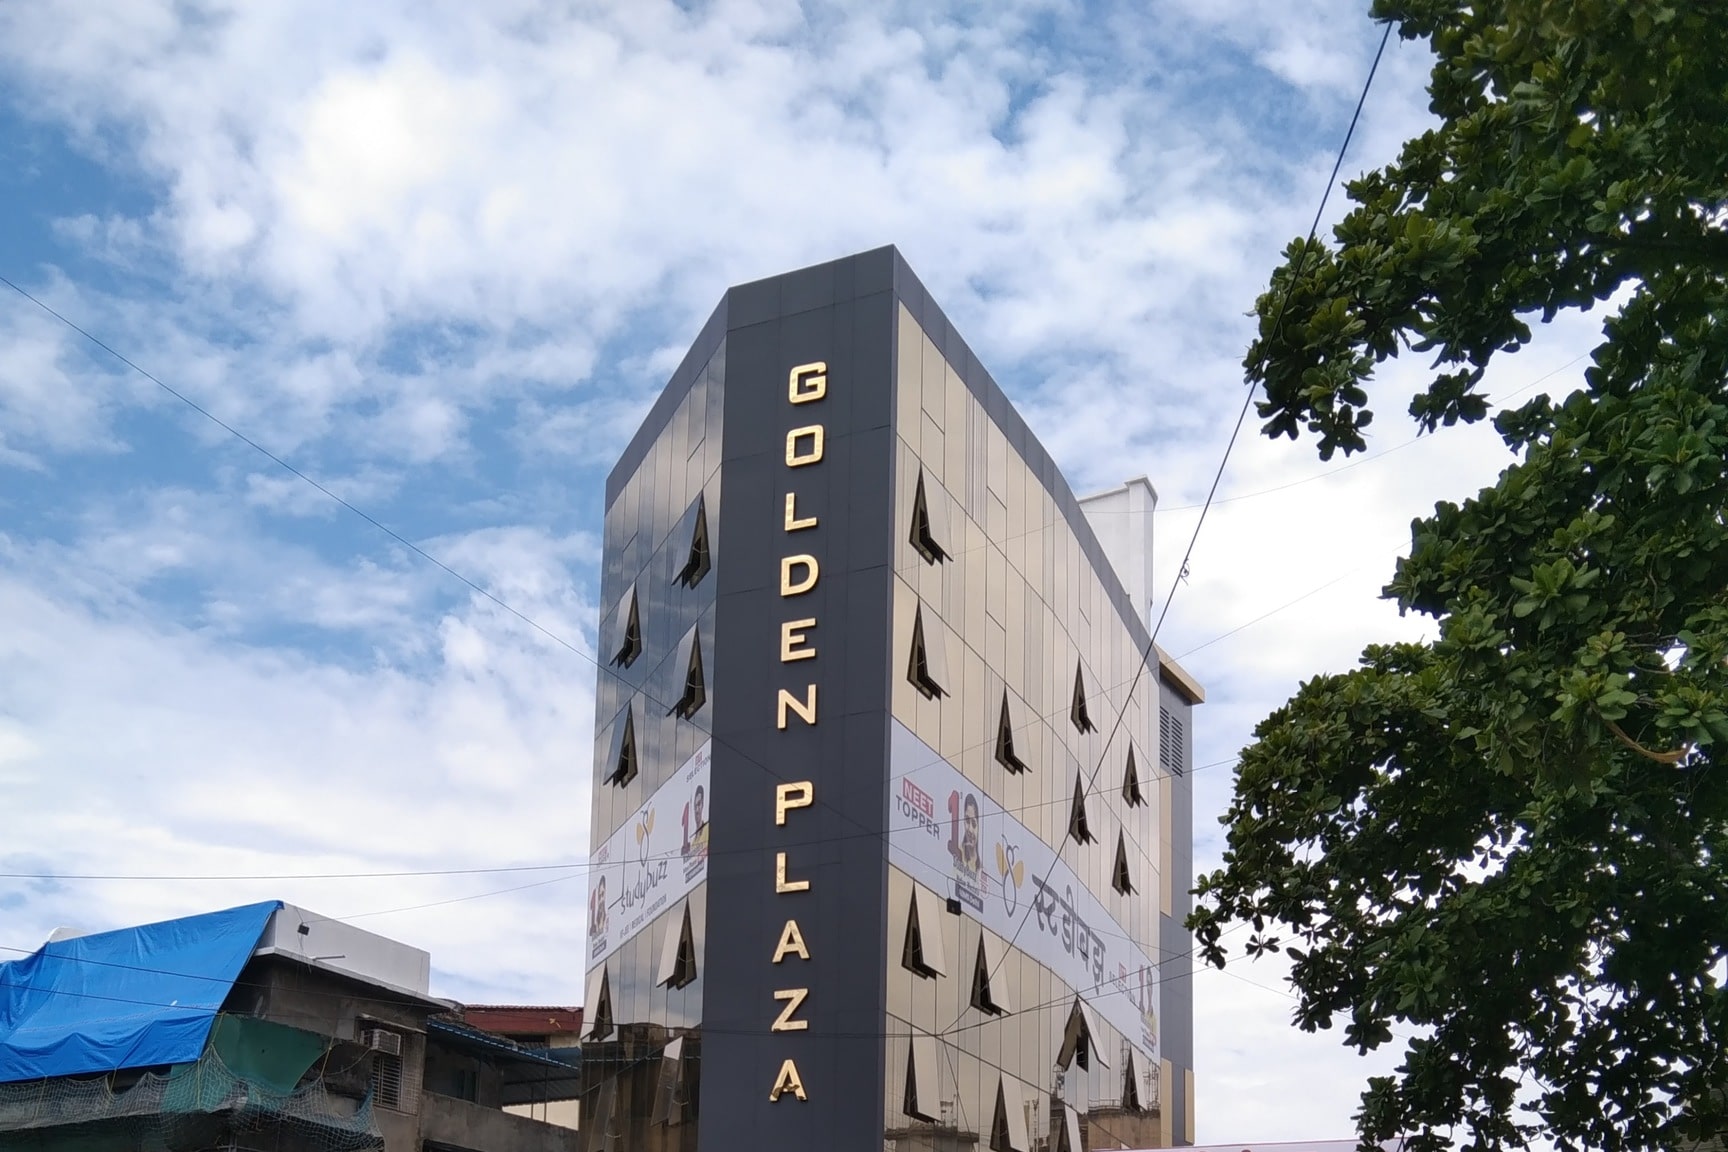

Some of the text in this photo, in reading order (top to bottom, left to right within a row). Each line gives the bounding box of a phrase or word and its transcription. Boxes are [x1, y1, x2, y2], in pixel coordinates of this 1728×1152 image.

[777, 361, 828, 730] GOLDEN
[895, 795, 940, 840] TOPPER
[904, 779, 933, 818] NEET
[769, 780, 814, 1102] PLAZA
